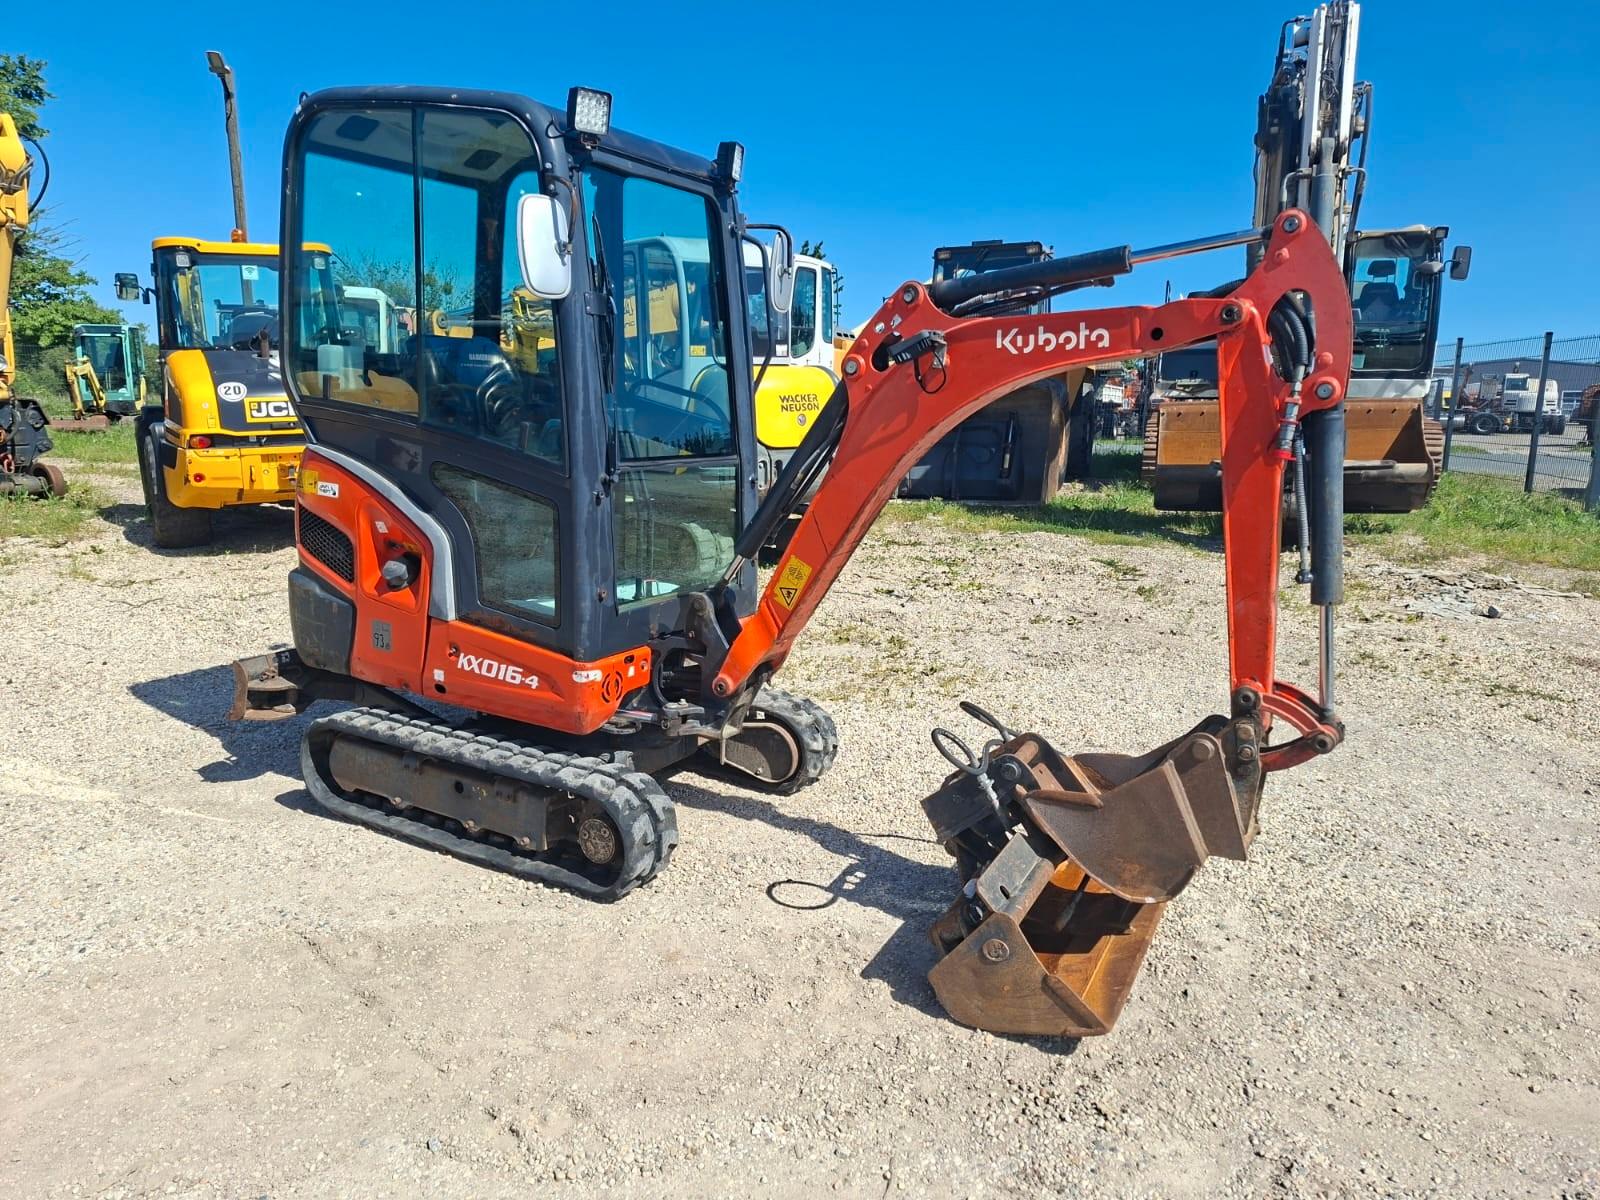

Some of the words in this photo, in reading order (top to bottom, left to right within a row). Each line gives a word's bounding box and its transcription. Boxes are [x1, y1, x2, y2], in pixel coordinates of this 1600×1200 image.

[996, 322, 1110, 355] Kubota
[223, 385, 242, 396] 20
[779, 394, 818, 403] WACKER
[781, 403, 819, 412] NEUSON
[457, 653, 539, 690] KX016-4
